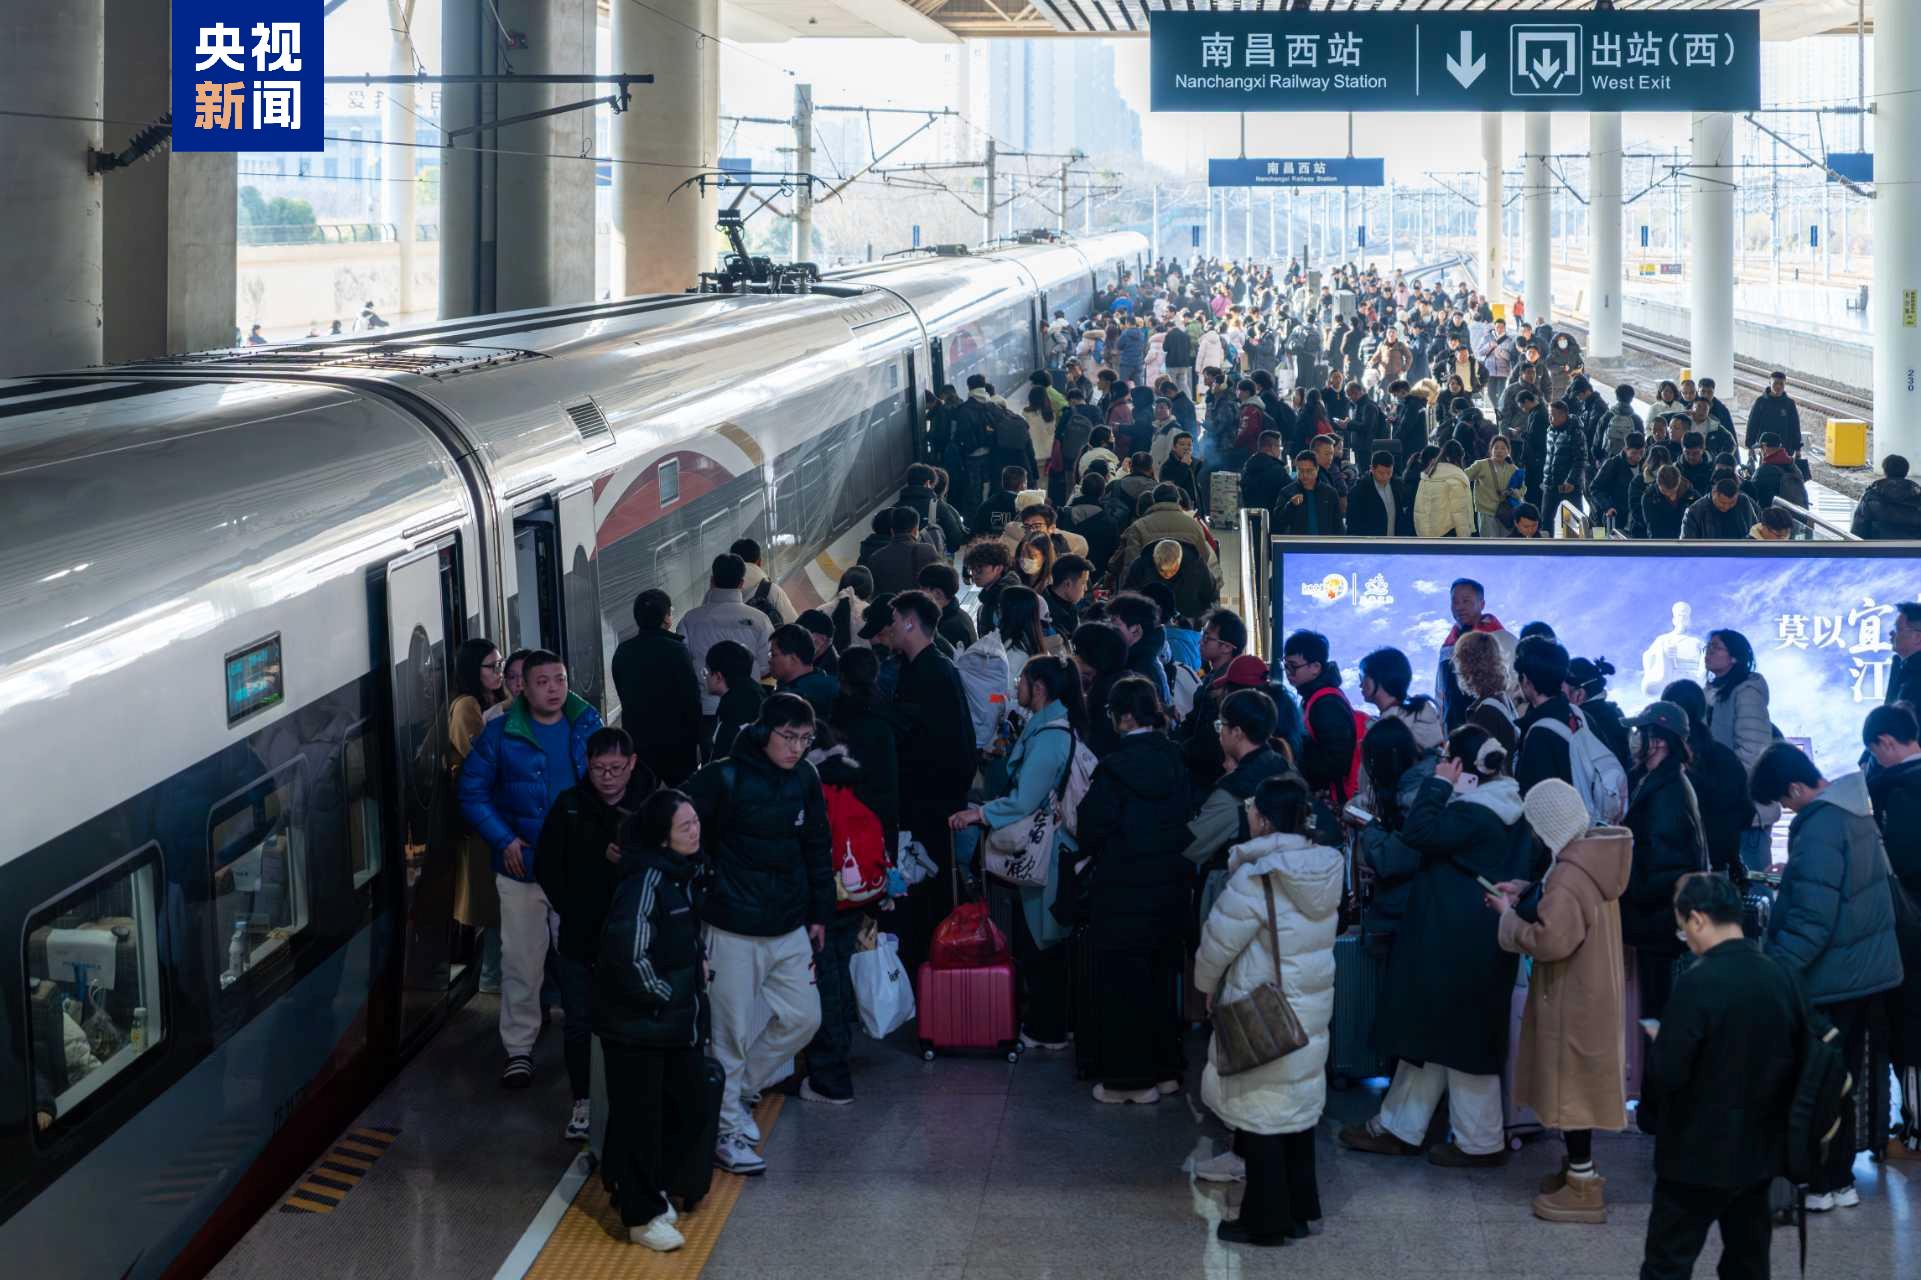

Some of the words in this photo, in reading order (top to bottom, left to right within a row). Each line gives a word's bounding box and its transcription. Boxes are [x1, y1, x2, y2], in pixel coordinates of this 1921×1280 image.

[1200, 31, 1364, 69] 南昌西站
[1175, 73, 1266, 92] Nanchangxi
[1269, 73, 1331, 92] Railway
[1333, 73, 1388, 89] Station
[1591, 75, 1635, 90] West
[1638, 74, 1672, 90] Exit
[1266, 161, 1327, 175] 南昌西站
